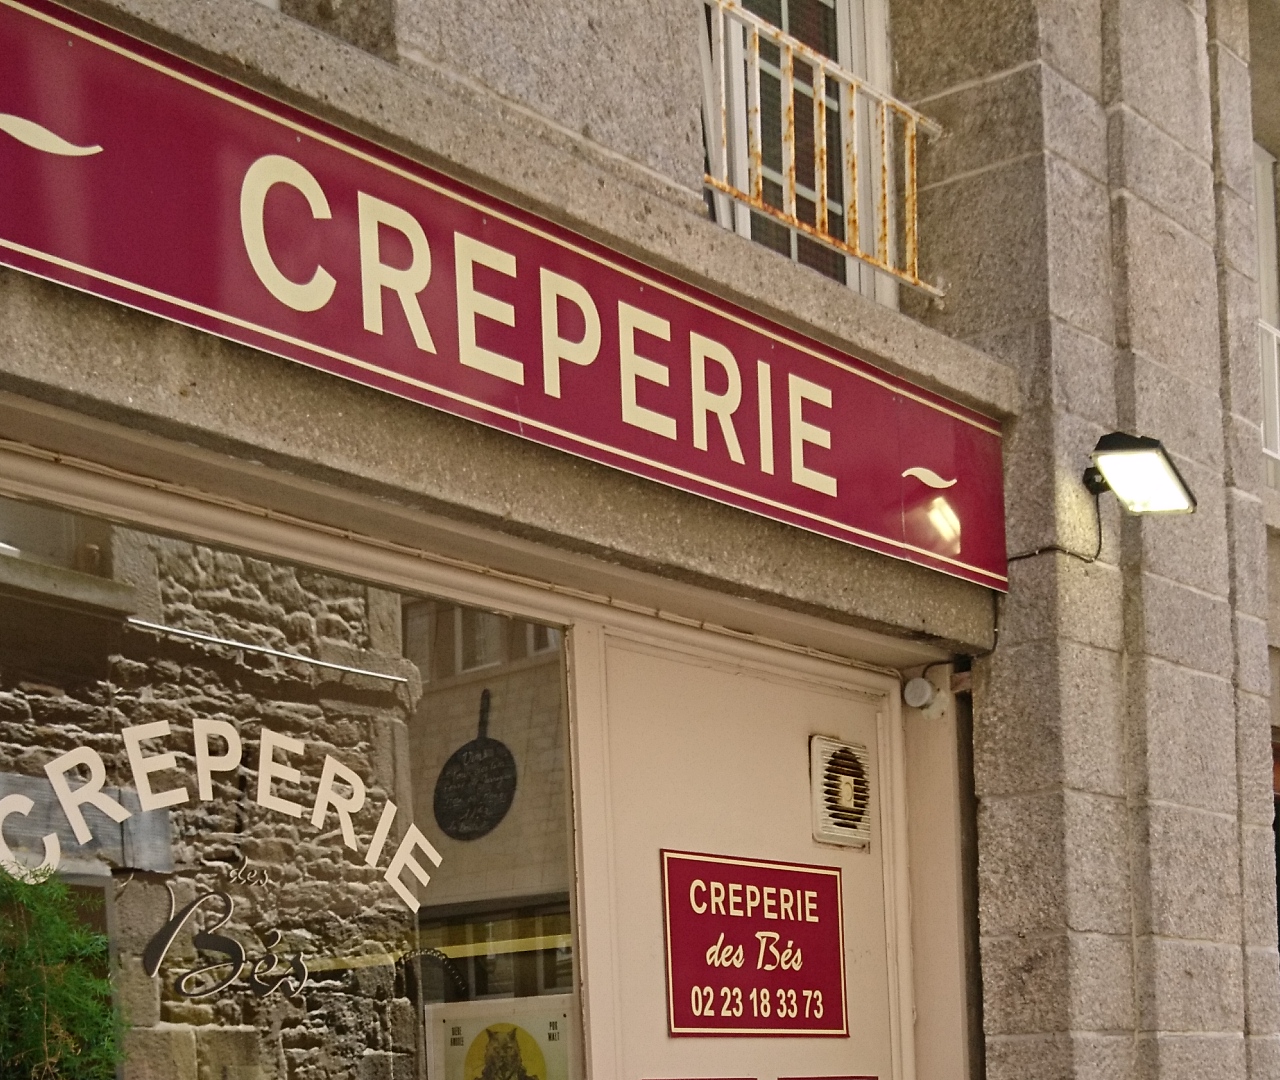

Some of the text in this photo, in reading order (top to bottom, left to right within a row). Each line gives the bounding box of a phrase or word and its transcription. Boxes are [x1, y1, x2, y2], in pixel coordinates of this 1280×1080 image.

[240, 154, 838, 497] CREPERIE
[229, 855, 269, 887] des
[689, 878, 820, 923] CREPERIE
[142, 882, 308, 999] Bés
[705, 930, 803, 972] des Bés
[690, 985, 824, 1019] 02 23 18 33 73
